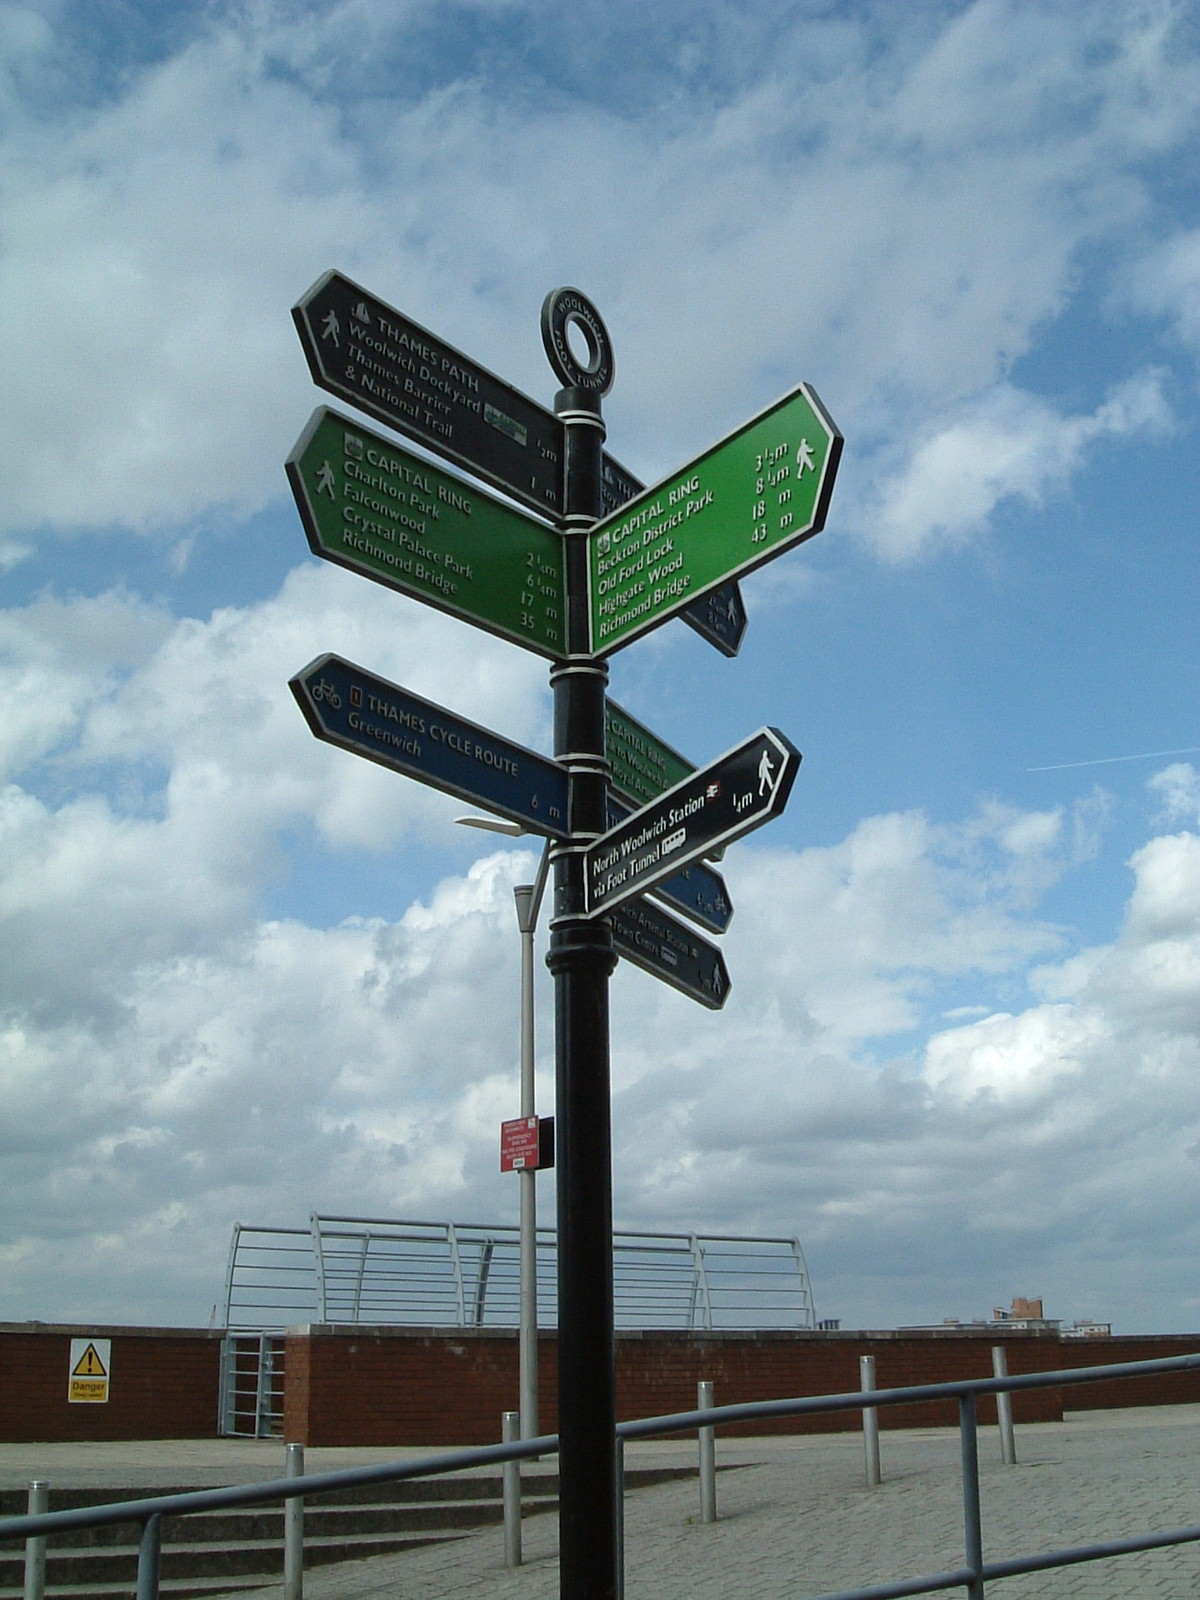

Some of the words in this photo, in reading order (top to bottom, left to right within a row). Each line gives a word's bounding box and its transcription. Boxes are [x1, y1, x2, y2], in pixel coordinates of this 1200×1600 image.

[377, 317, 437, 365] THAMES
[442, 358, 479, 393] PATH
[559, 298, 604, 343] WOOLWICH
[345, 364, 356, 381] &
[361, 373, 418, 418] National
[423, 408, 453, 438] Trail
[347, 344, 400, 385] Thames
[404, 377, 451, 415] Barrier
[350, 322, 416, 374] Woolwich
[420, 366, 480, 413] Dockyard
[344, 461, 405, 500] Charlton
[409, 492, 440, 520] Park
[344, 485, 426, 534] Falconwood
[367, 449, 432, 495] CAPITAL
[438, 485, 472, 515] RING
[612, 500, 665, 544] CAPITAL
[669, 475, 700, 508] RING
[343, 506, 395, 543] Crystal
[400, 531, 440, 563] Palace
[445, 554, 473, 581] Park
[521, 590, 534, 606] 17
[546, 606, 557, 619] m
[597, 541, 640, 576] Beckton
[642, 512, 684, 545] District
[686, 488, 714, 519] Park
[598, 574, 617, 596] Old
[619, 562, 644, 585] Ford
[646, 537, 674, 565] Lock
[599, 580, 646, 617] Highgate
[648, 553, 684, 585] Wood
[752, 501, 766, 521] 18
[778, 489, 792, 504] m
[343, 529, 412, 572] Richmond
[416, 559, 458, 595] Bridge
[521, 612, 535, 629] 35
[546, 628, 557, 641] m
[599, 596, 651, 638] Richmond
[654, 573, 691, 607] Bridge
[751, 524, 768, 544] 43
[780, 512, 793, 528] m
[349, 712, 422, 758] Greenwich
[531, 795, 539, 809] 6
[549, 805, 561, 819] m
[367, 694, 426, 733] THAMES
[430, 725, 471, 757] CYCLE
[475, 745, 519, 777] ROUTE
[593, 850, 620, 878] North
[620, 816, 667, 858] Woolwich
[668, 795, 706, 828] Station
[593, 880, 606, 898] via
[607, 865, 628, 890] Foot
[629, 846, 662, 877] Tunnel
[72, 1381, 105, 1392] Danger
